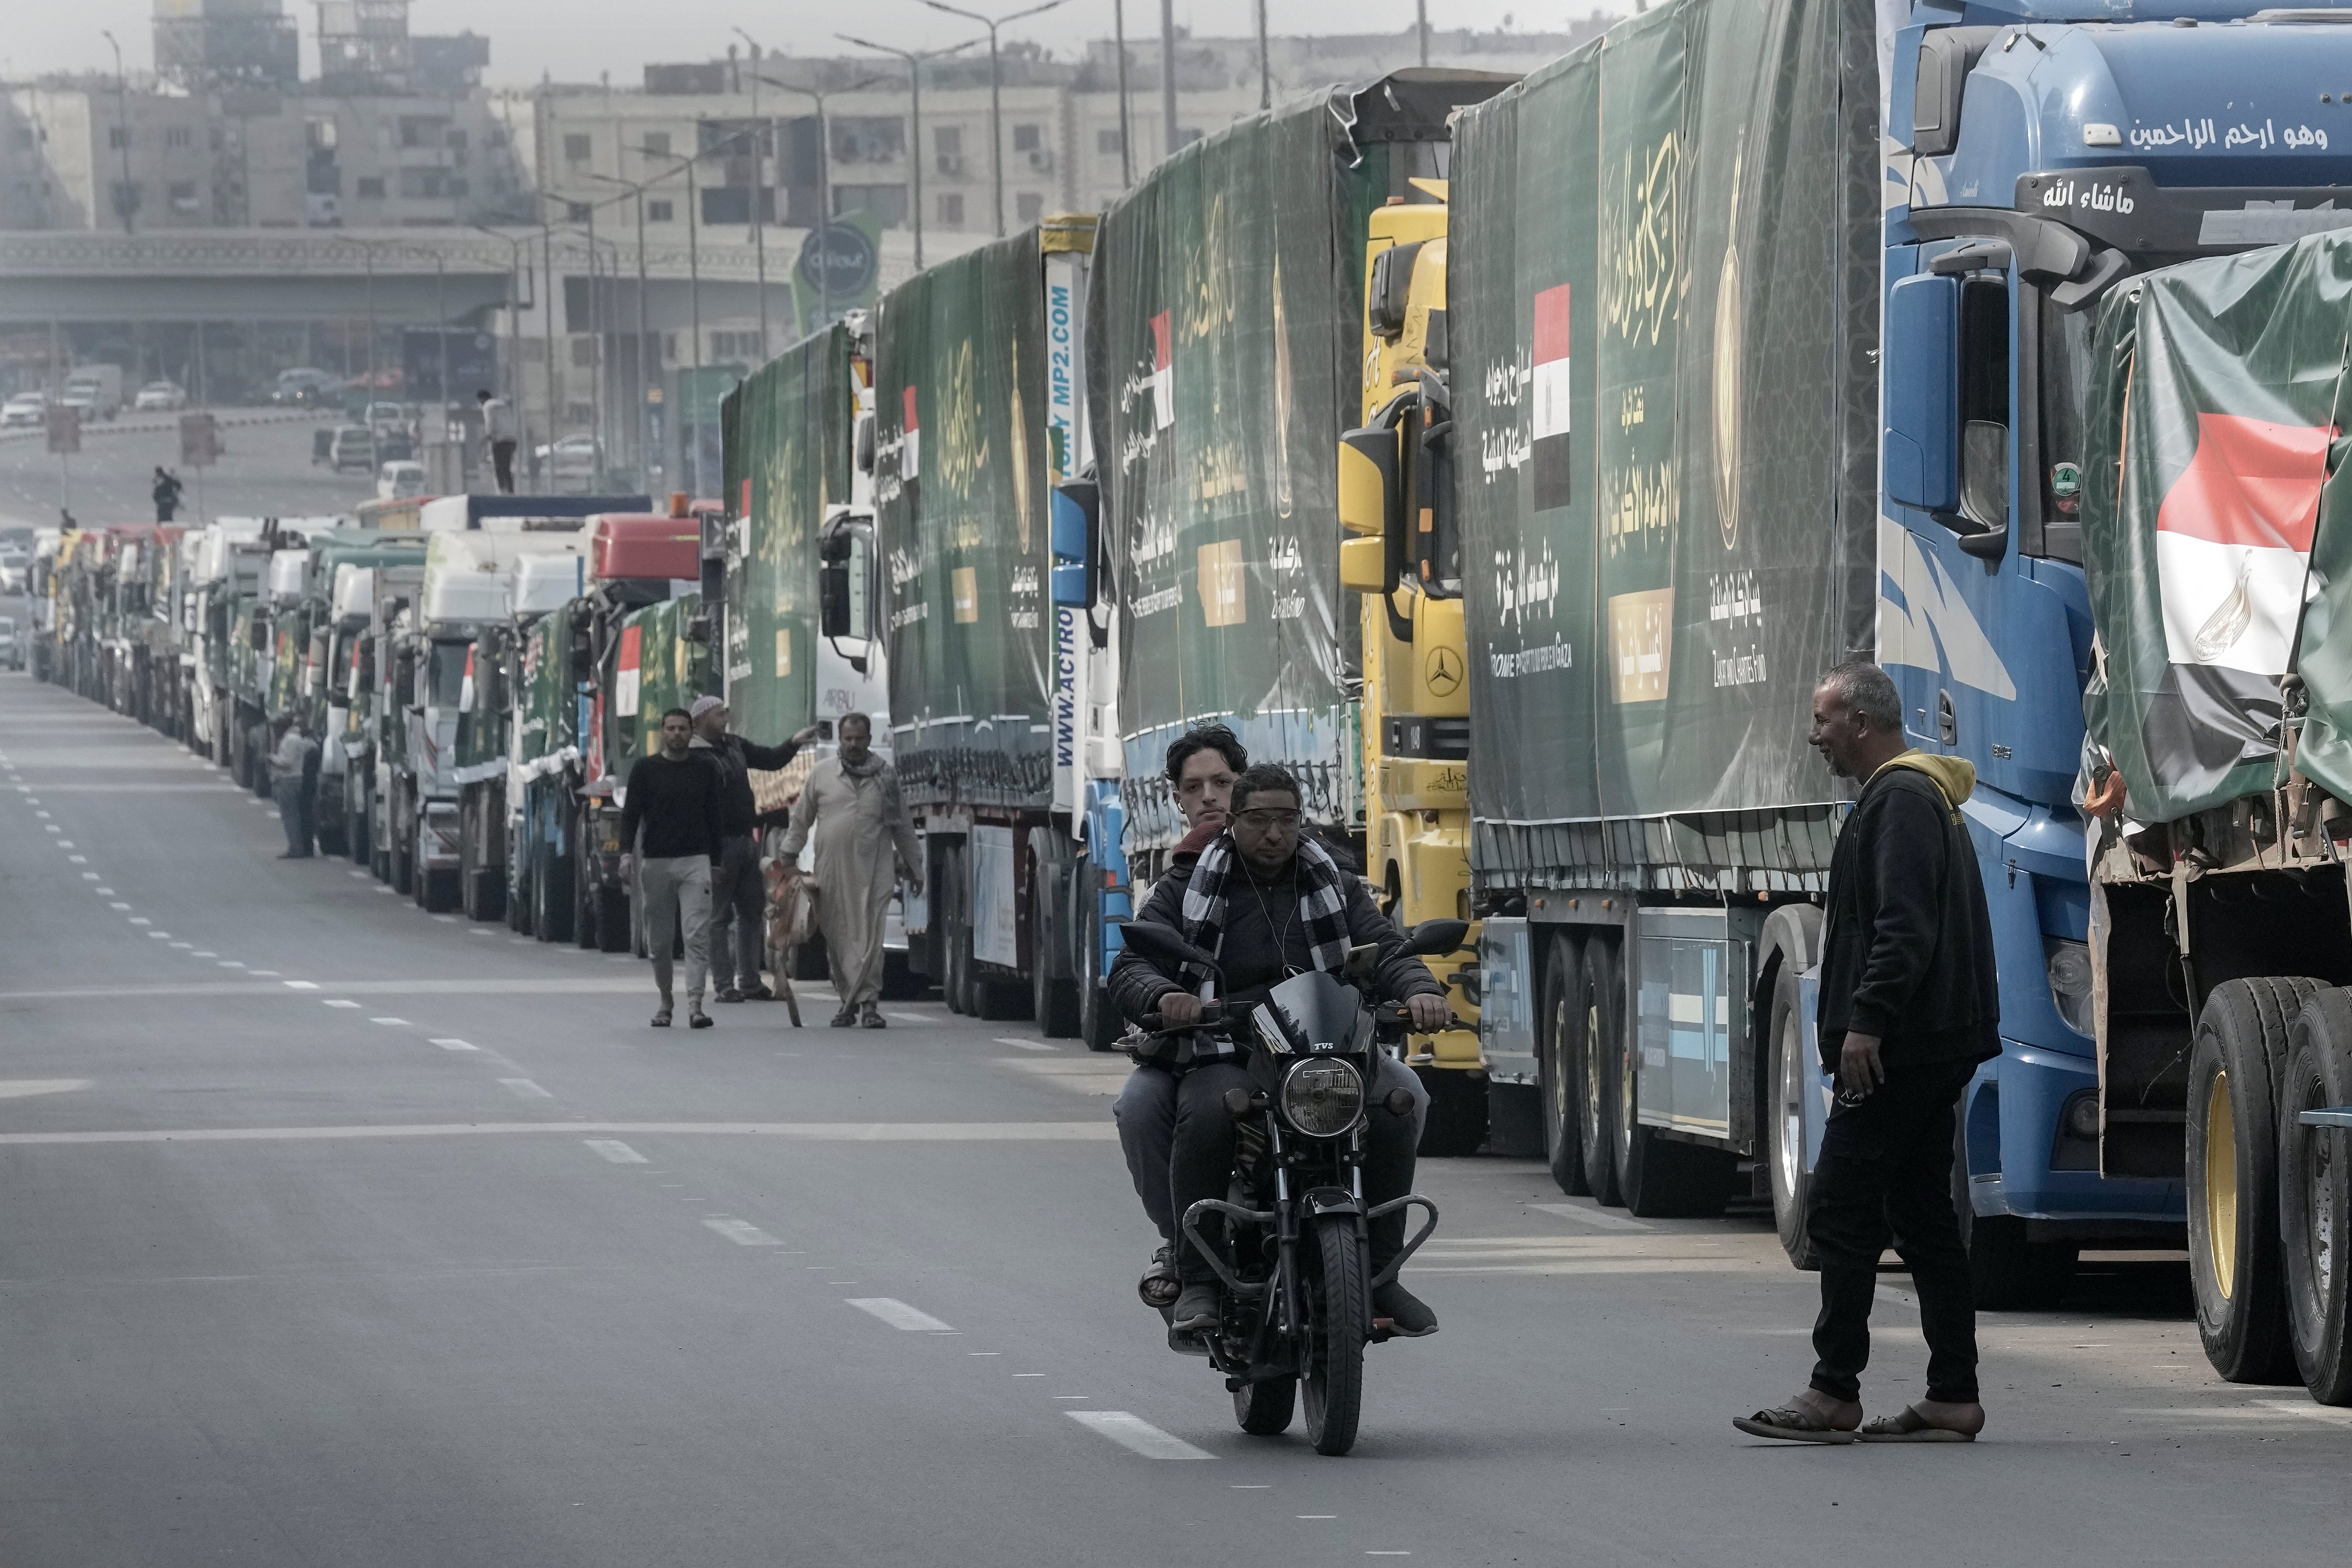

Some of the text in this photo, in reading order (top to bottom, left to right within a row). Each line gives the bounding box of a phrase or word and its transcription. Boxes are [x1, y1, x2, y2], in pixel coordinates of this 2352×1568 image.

[2130, 117, 2329, 151] وهو ارحم الراحمين
[2043, 178, 2134, 215] ماشاء الله
[1051, 286, 1071, 408] MP2.COM
[2062, 469, 2070, 482] 4
[1556, 631, 1572, 668] GAZA
[1752, 644, 1766, 682] FUND
